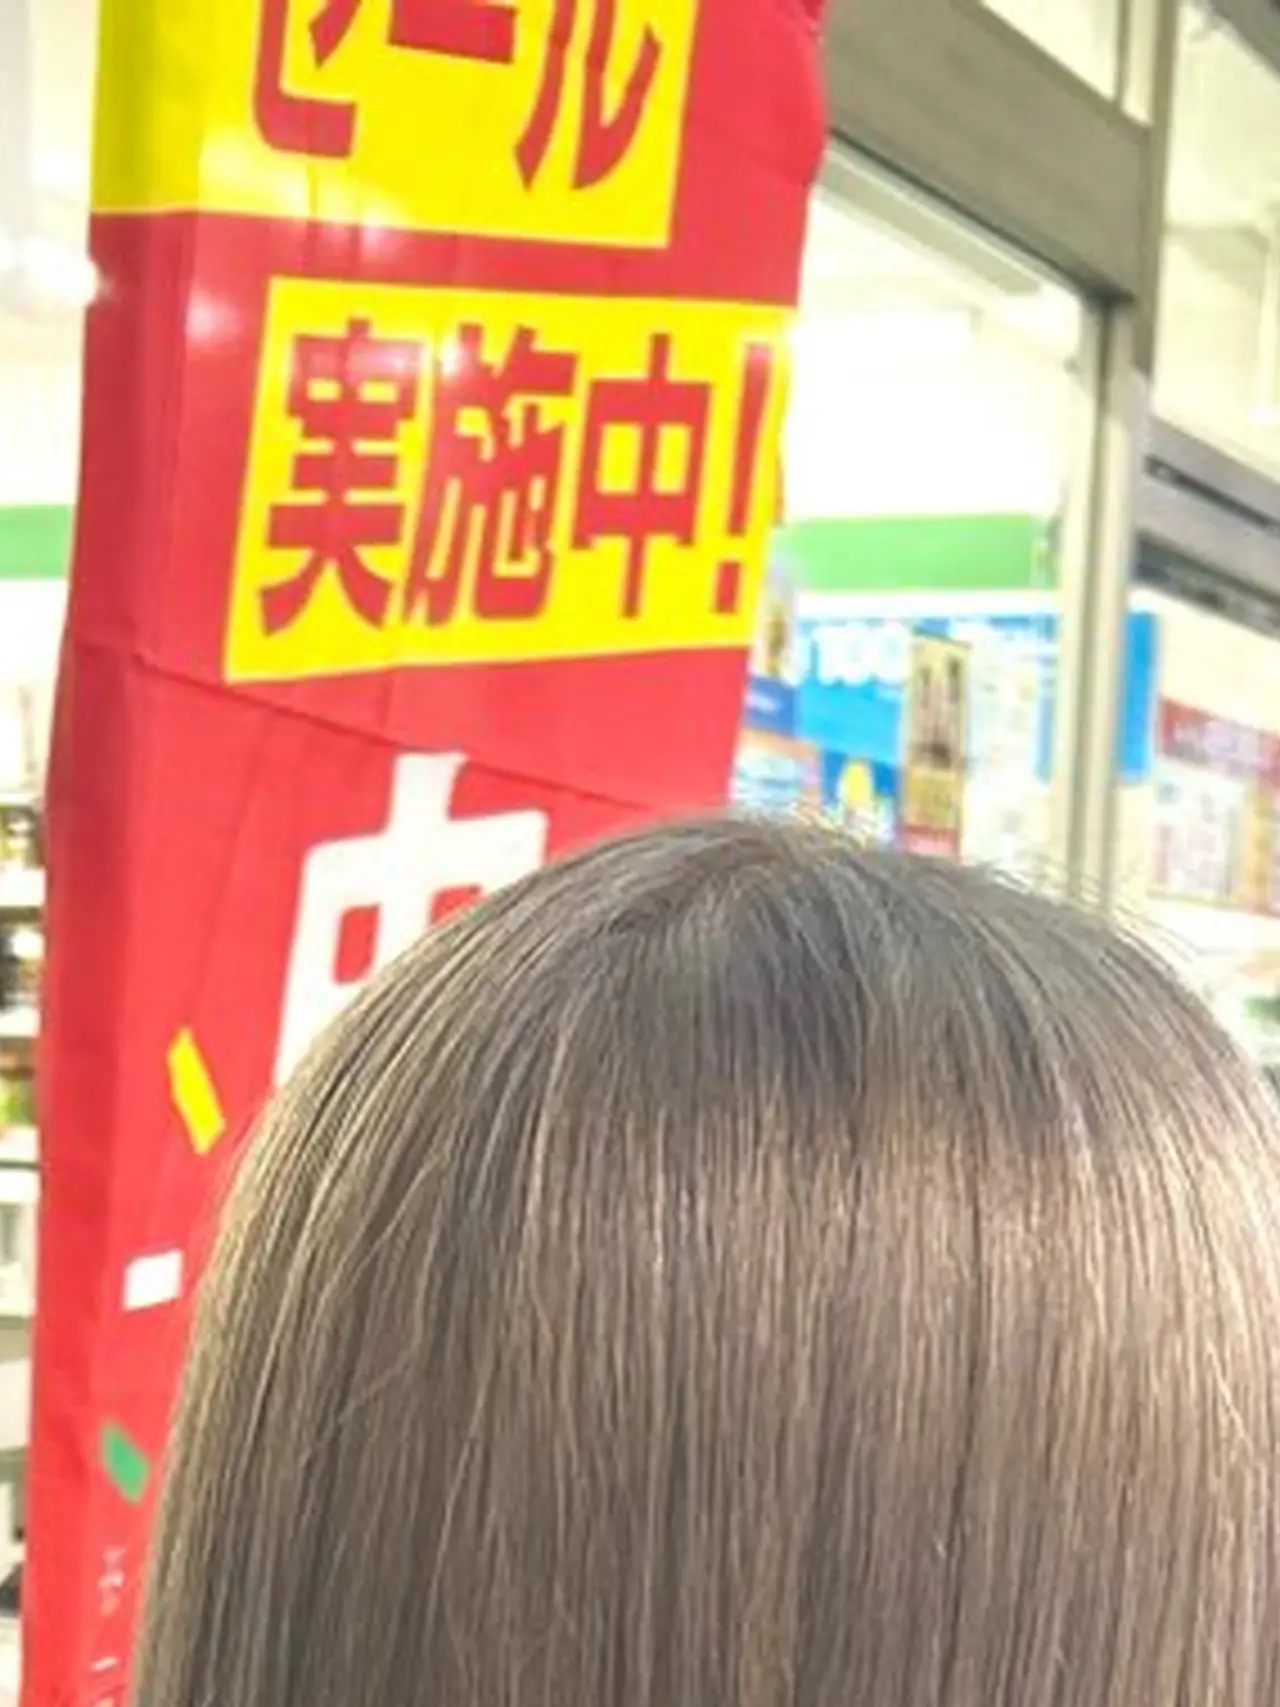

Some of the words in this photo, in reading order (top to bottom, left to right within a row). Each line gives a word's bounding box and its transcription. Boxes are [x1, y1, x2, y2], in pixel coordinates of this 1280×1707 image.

[253, 0, 664, 190] セール
[257, 317, 773, 637] 実施中!
